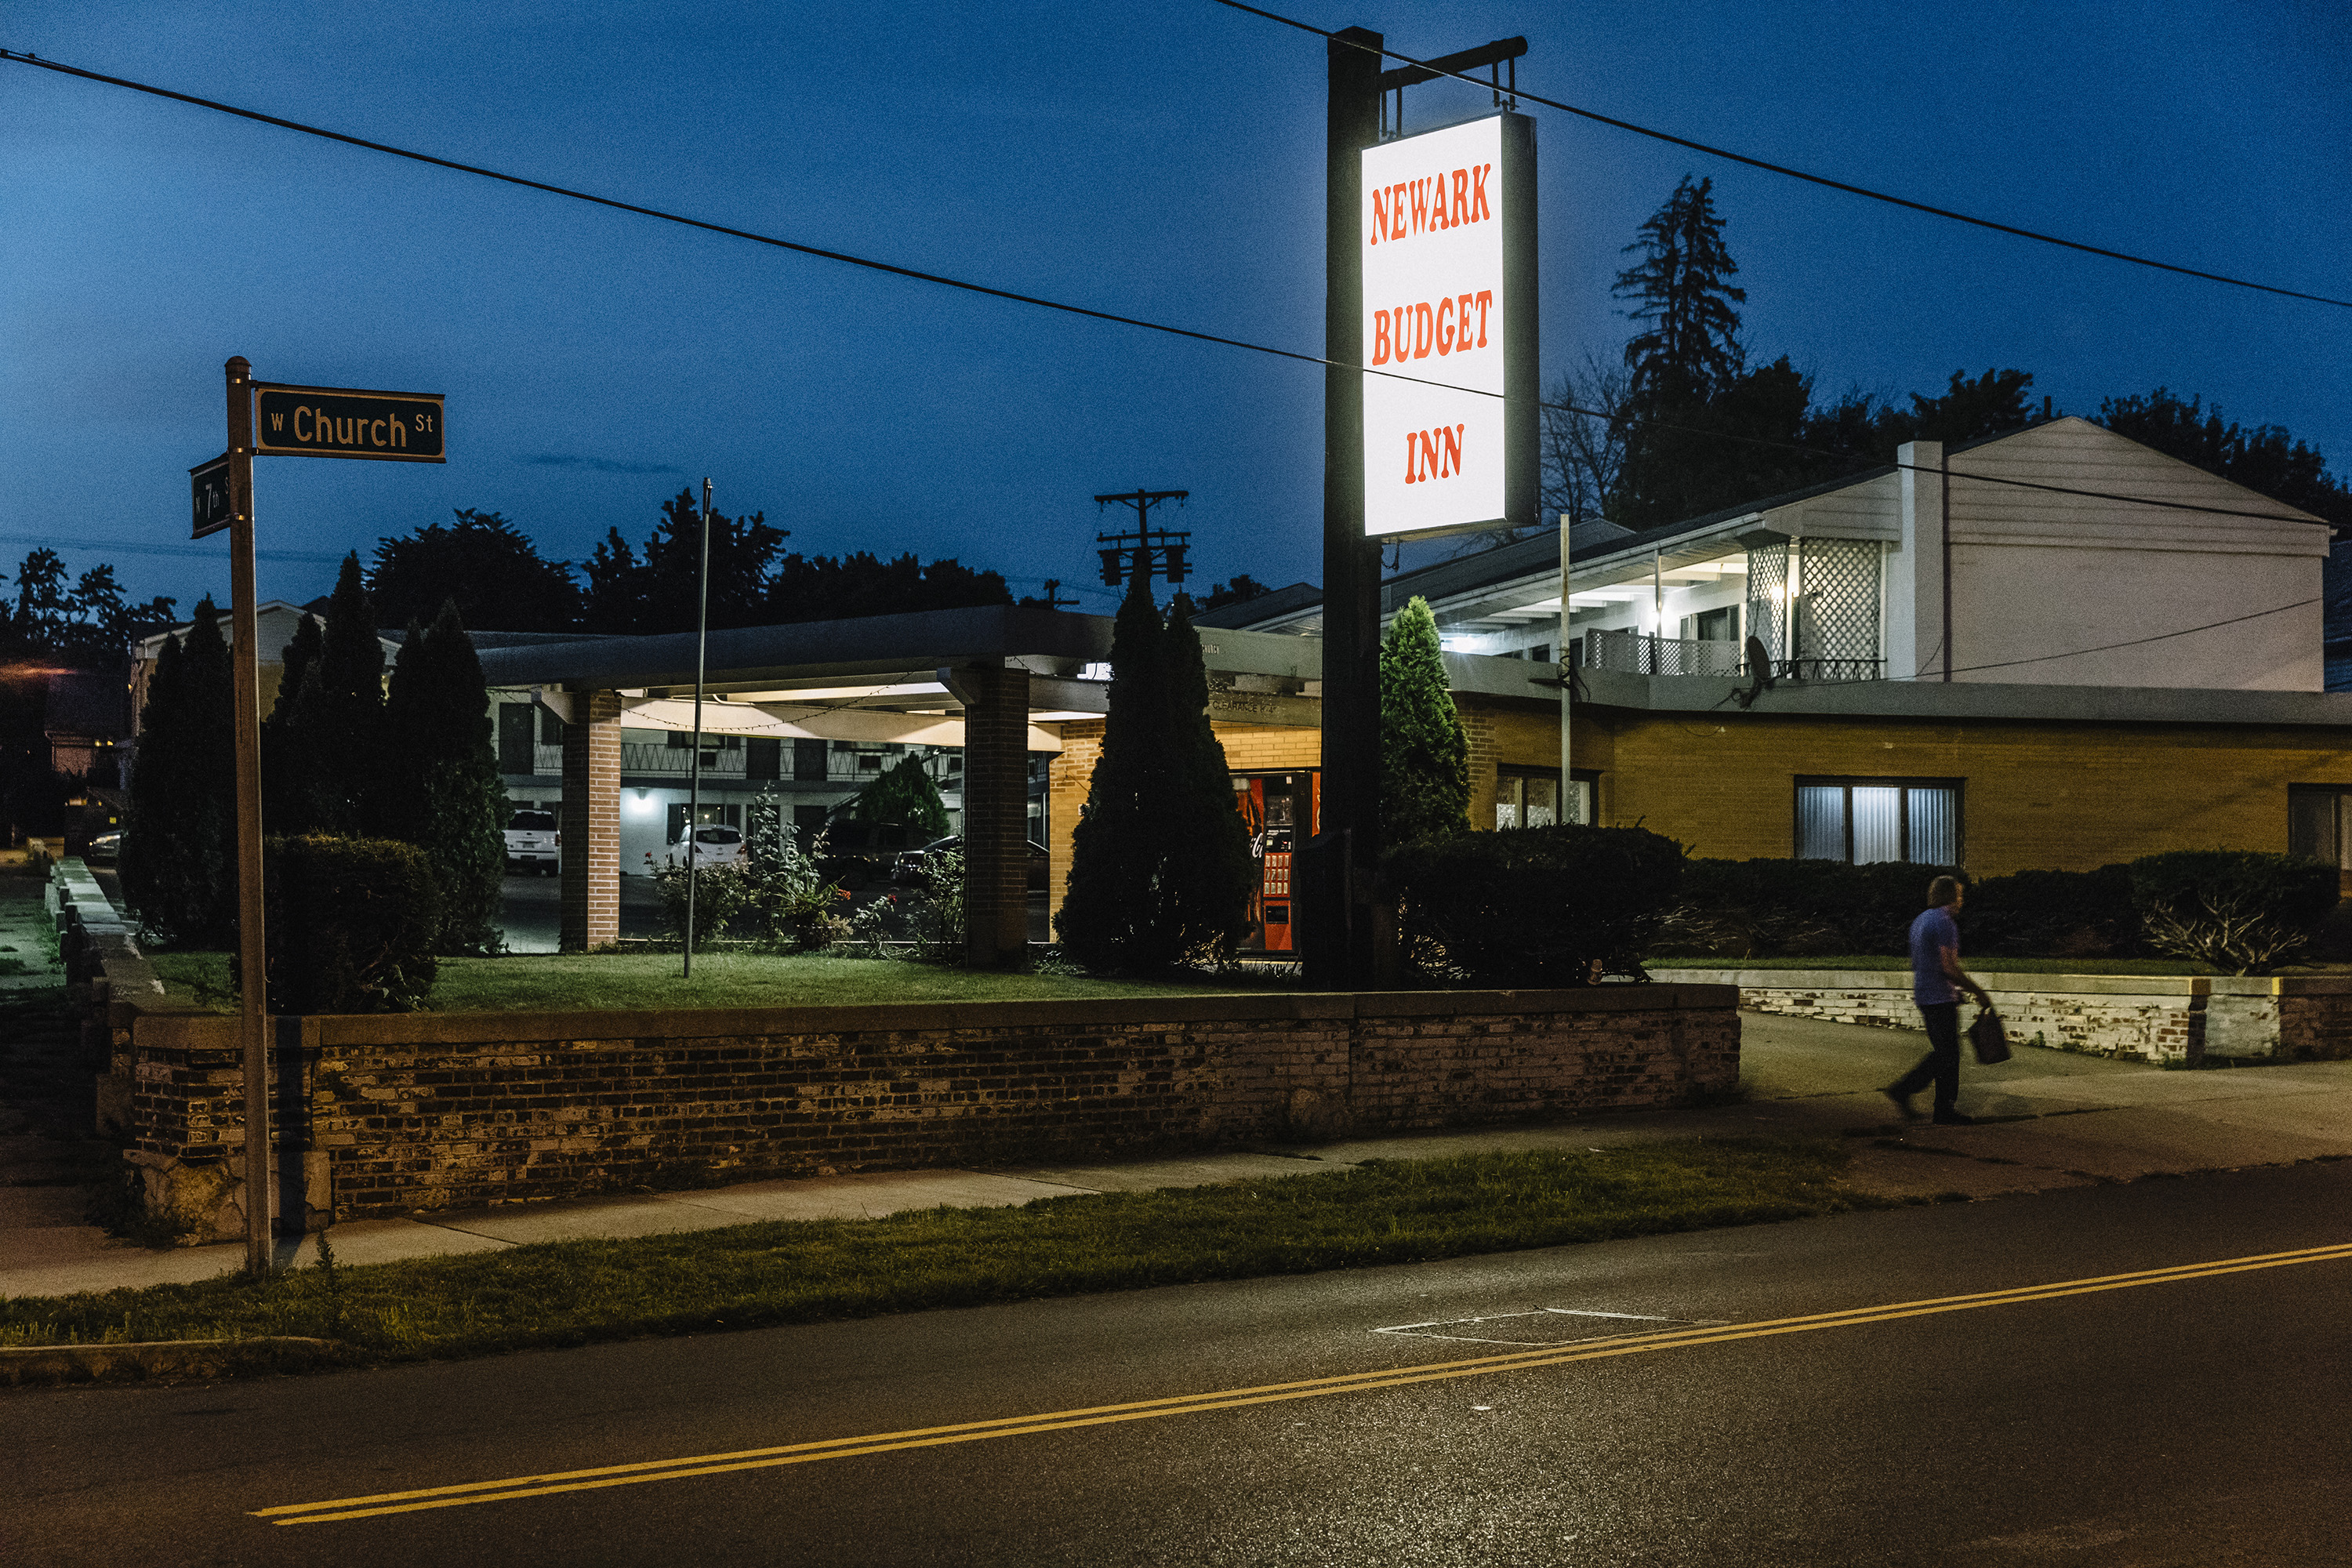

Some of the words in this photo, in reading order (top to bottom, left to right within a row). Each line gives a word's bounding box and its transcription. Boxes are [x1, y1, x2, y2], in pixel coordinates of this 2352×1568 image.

[1371, 163, 1491, 245] NEWARK
[1372, 289, 1492, 366] BUDGET
[270, 412, 284, 431] W
[294, 405, 407, 448] Church
[415, 413, 433, 433] St
[1404, 423, 1465, 485] INN
[195, 495, 201, 514] N
[205, 482, 220, 519] 7th
[1212, 700, 1258, 713] CLEARANCE
